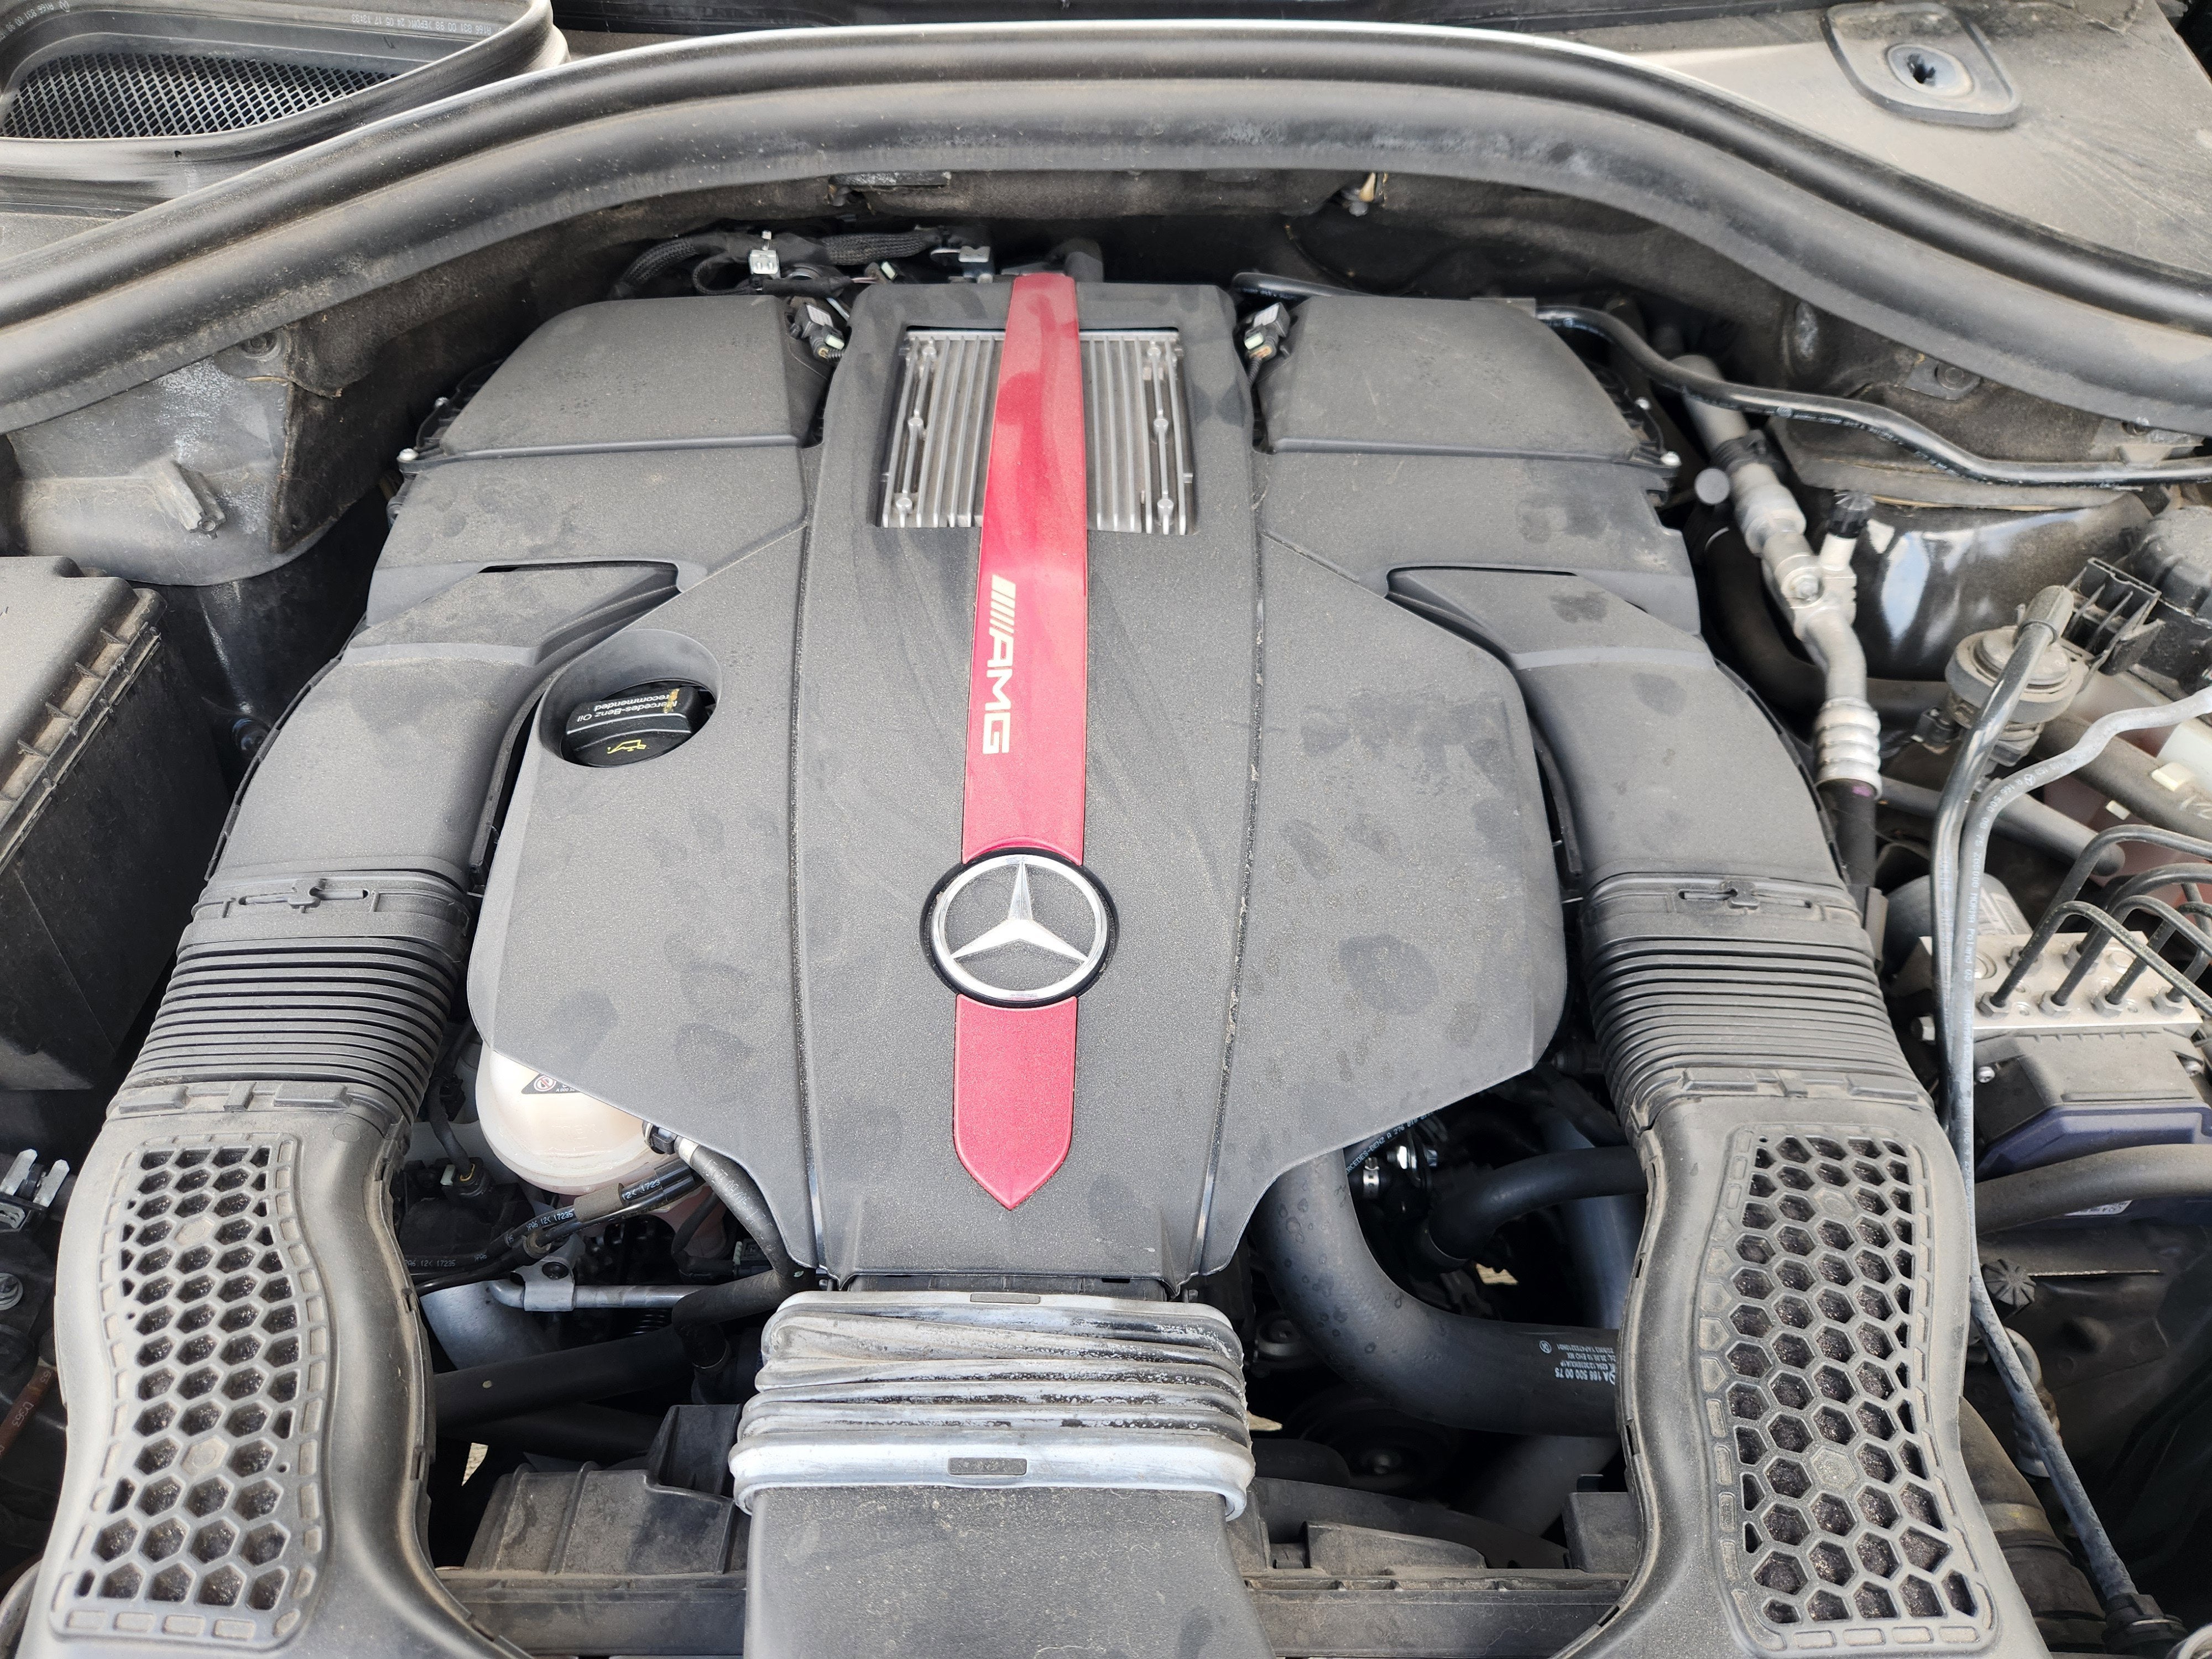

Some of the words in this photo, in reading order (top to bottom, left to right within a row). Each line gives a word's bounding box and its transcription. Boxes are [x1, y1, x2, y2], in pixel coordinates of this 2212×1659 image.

[594, 694, 670, 712] recommended
[577, 713, 593, 722] Oil
[1345, 1137, 1385, 1174] RCEDES-BENZ
[1394, 1125, 1405, 1135] 276
[553, 1209, 574, 1222] 17235
